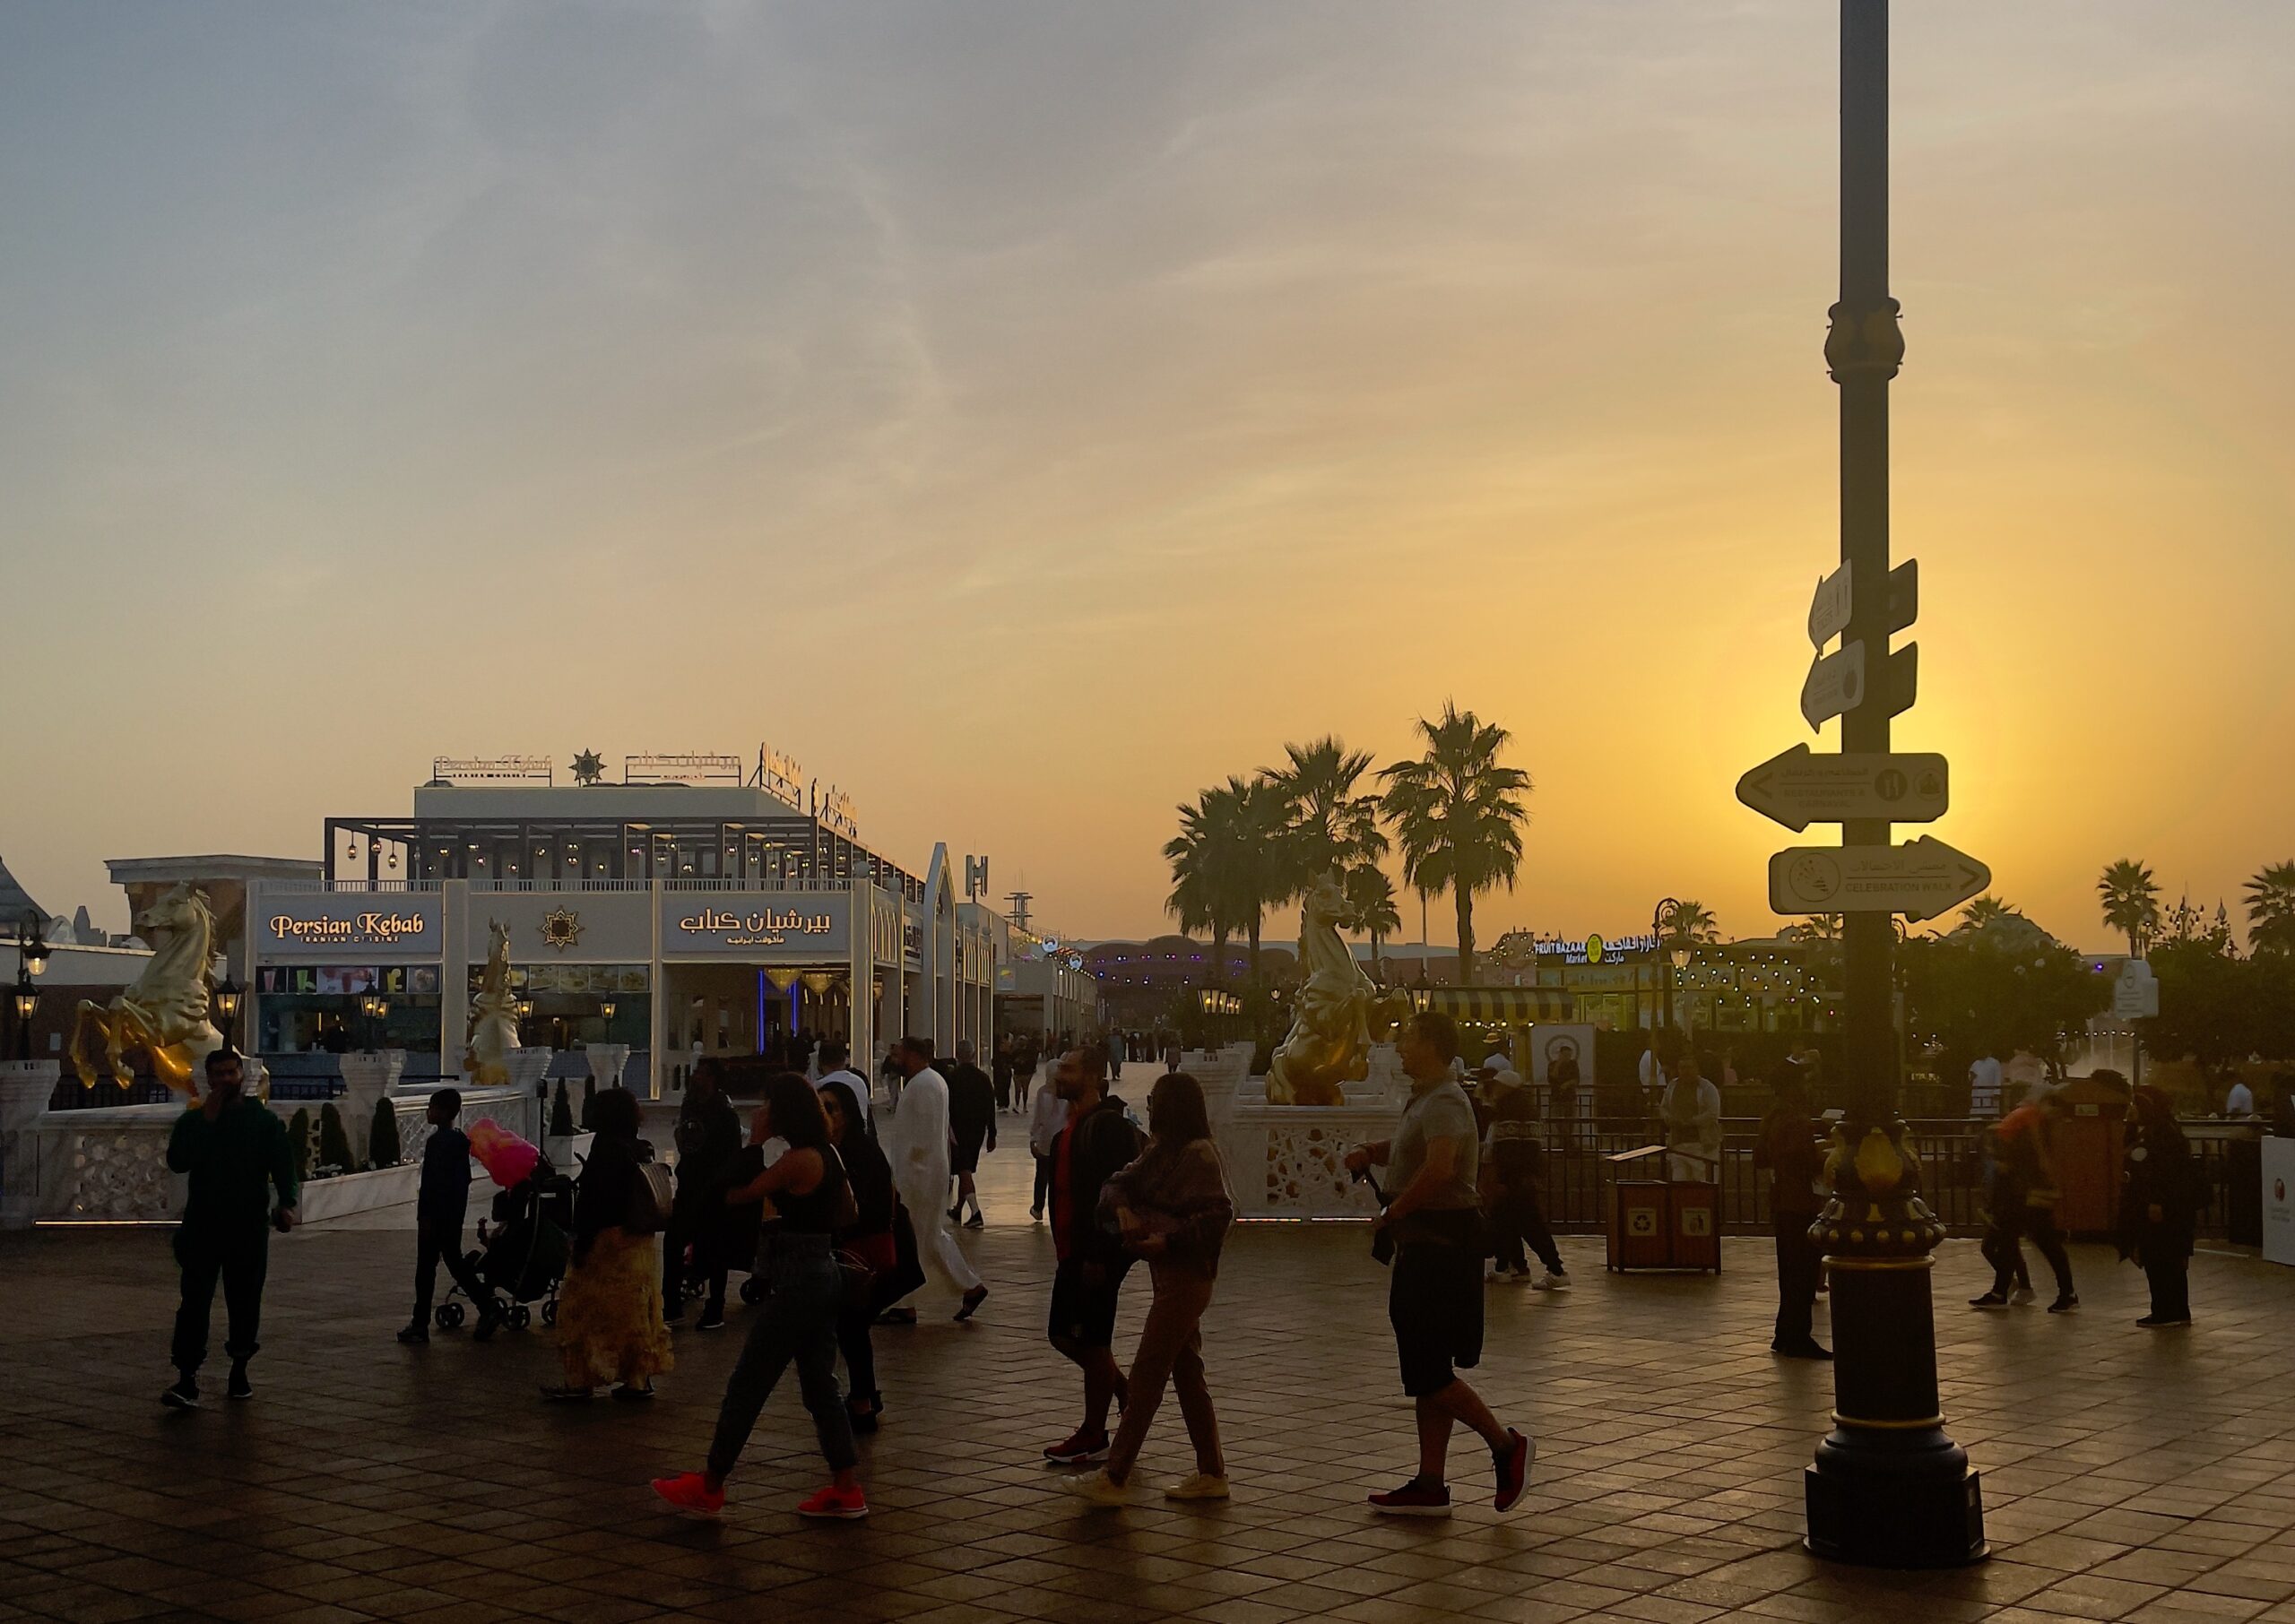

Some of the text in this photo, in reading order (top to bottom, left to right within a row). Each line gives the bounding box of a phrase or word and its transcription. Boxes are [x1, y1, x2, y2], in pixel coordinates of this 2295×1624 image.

[1845, 880, 1952, 893] CELEBRATION WALK
[270, 912, 424, 938] Persian Kebab
[680, 908, 831, 934] بيرشيان كباب
[1534, 941, 1586, 955] FRUIT BAZAAR
[1565, 954, 1588, 964] Market
[1604, 951, 1624, 965] ماركت
